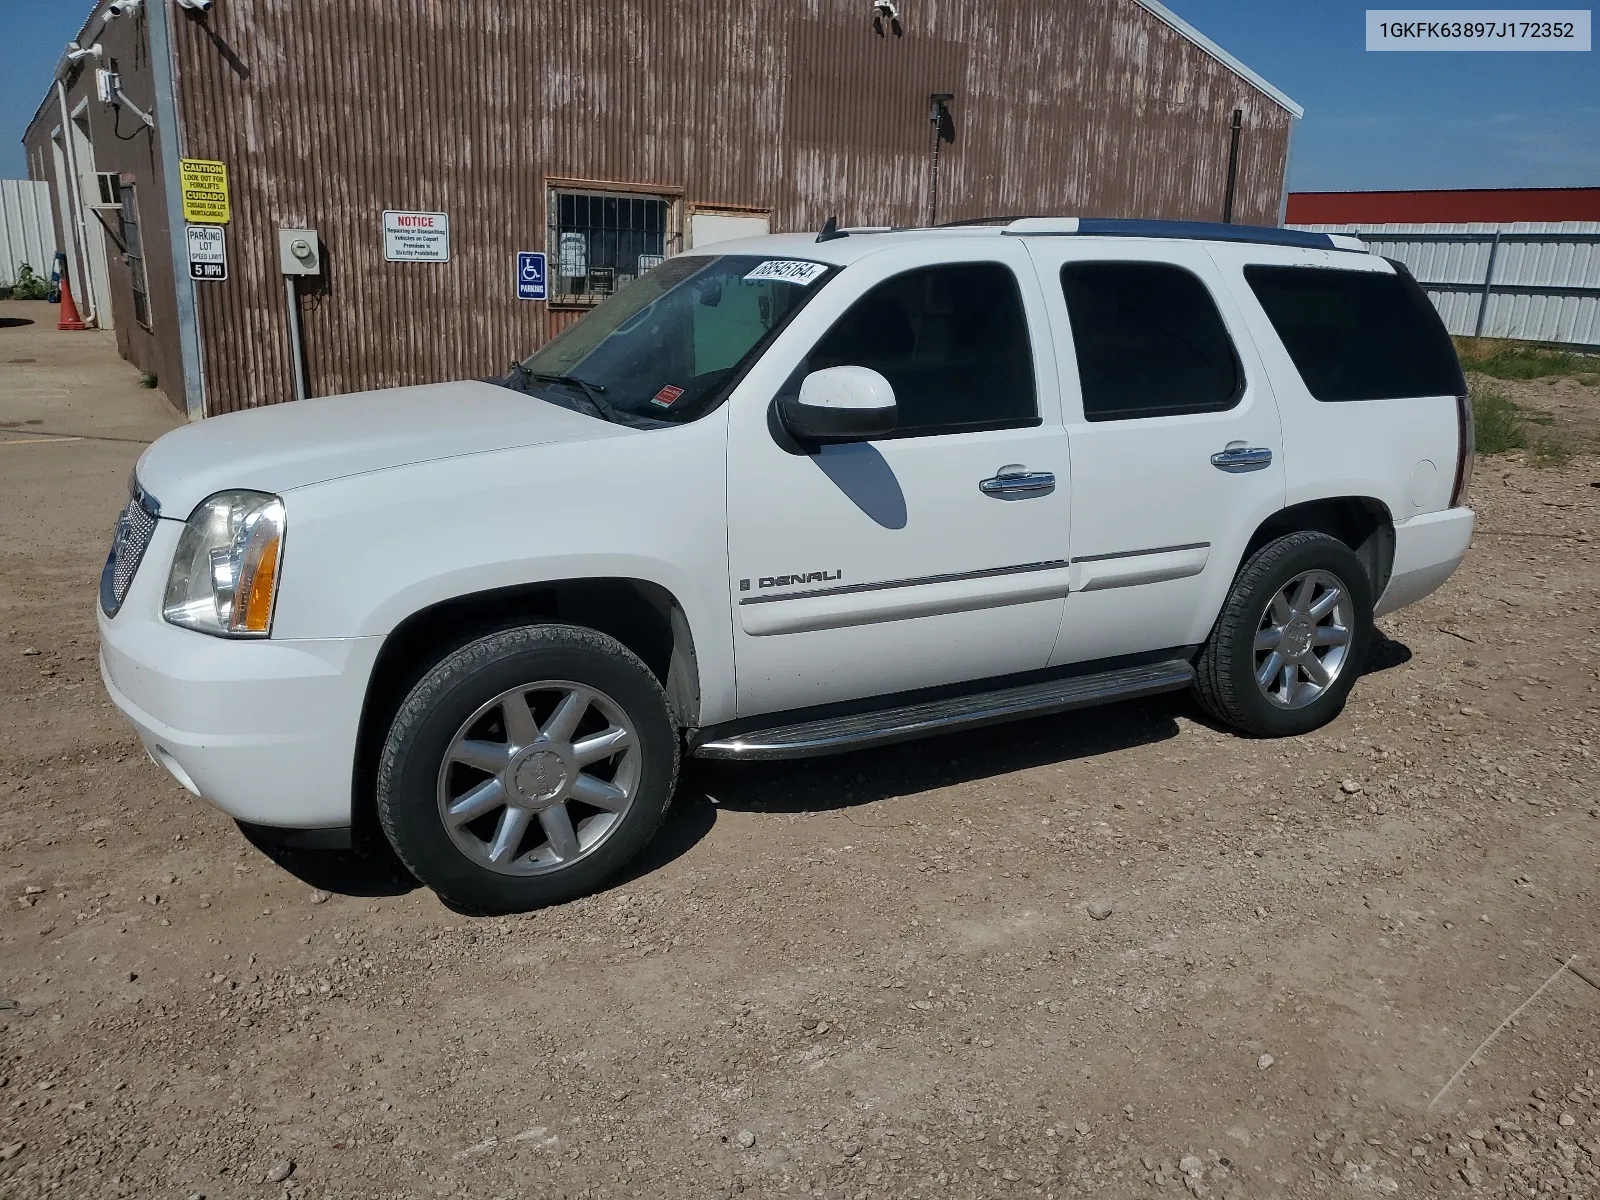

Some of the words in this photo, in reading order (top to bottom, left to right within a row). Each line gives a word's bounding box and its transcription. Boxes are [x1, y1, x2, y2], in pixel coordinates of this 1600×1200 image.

[184, 163, 222, 173] CAUTION
[187, 191, 224, 201] CUIDADO
[398, 216, 434, 227] NOTICE
[190, 231, 220, 240] PARKING
[200, 242, 212, 250] LOT
[195, 265, 202, 275] 5
[205, 265, 221, 275] MPH
[759, 569, 841, 588] DENALI
